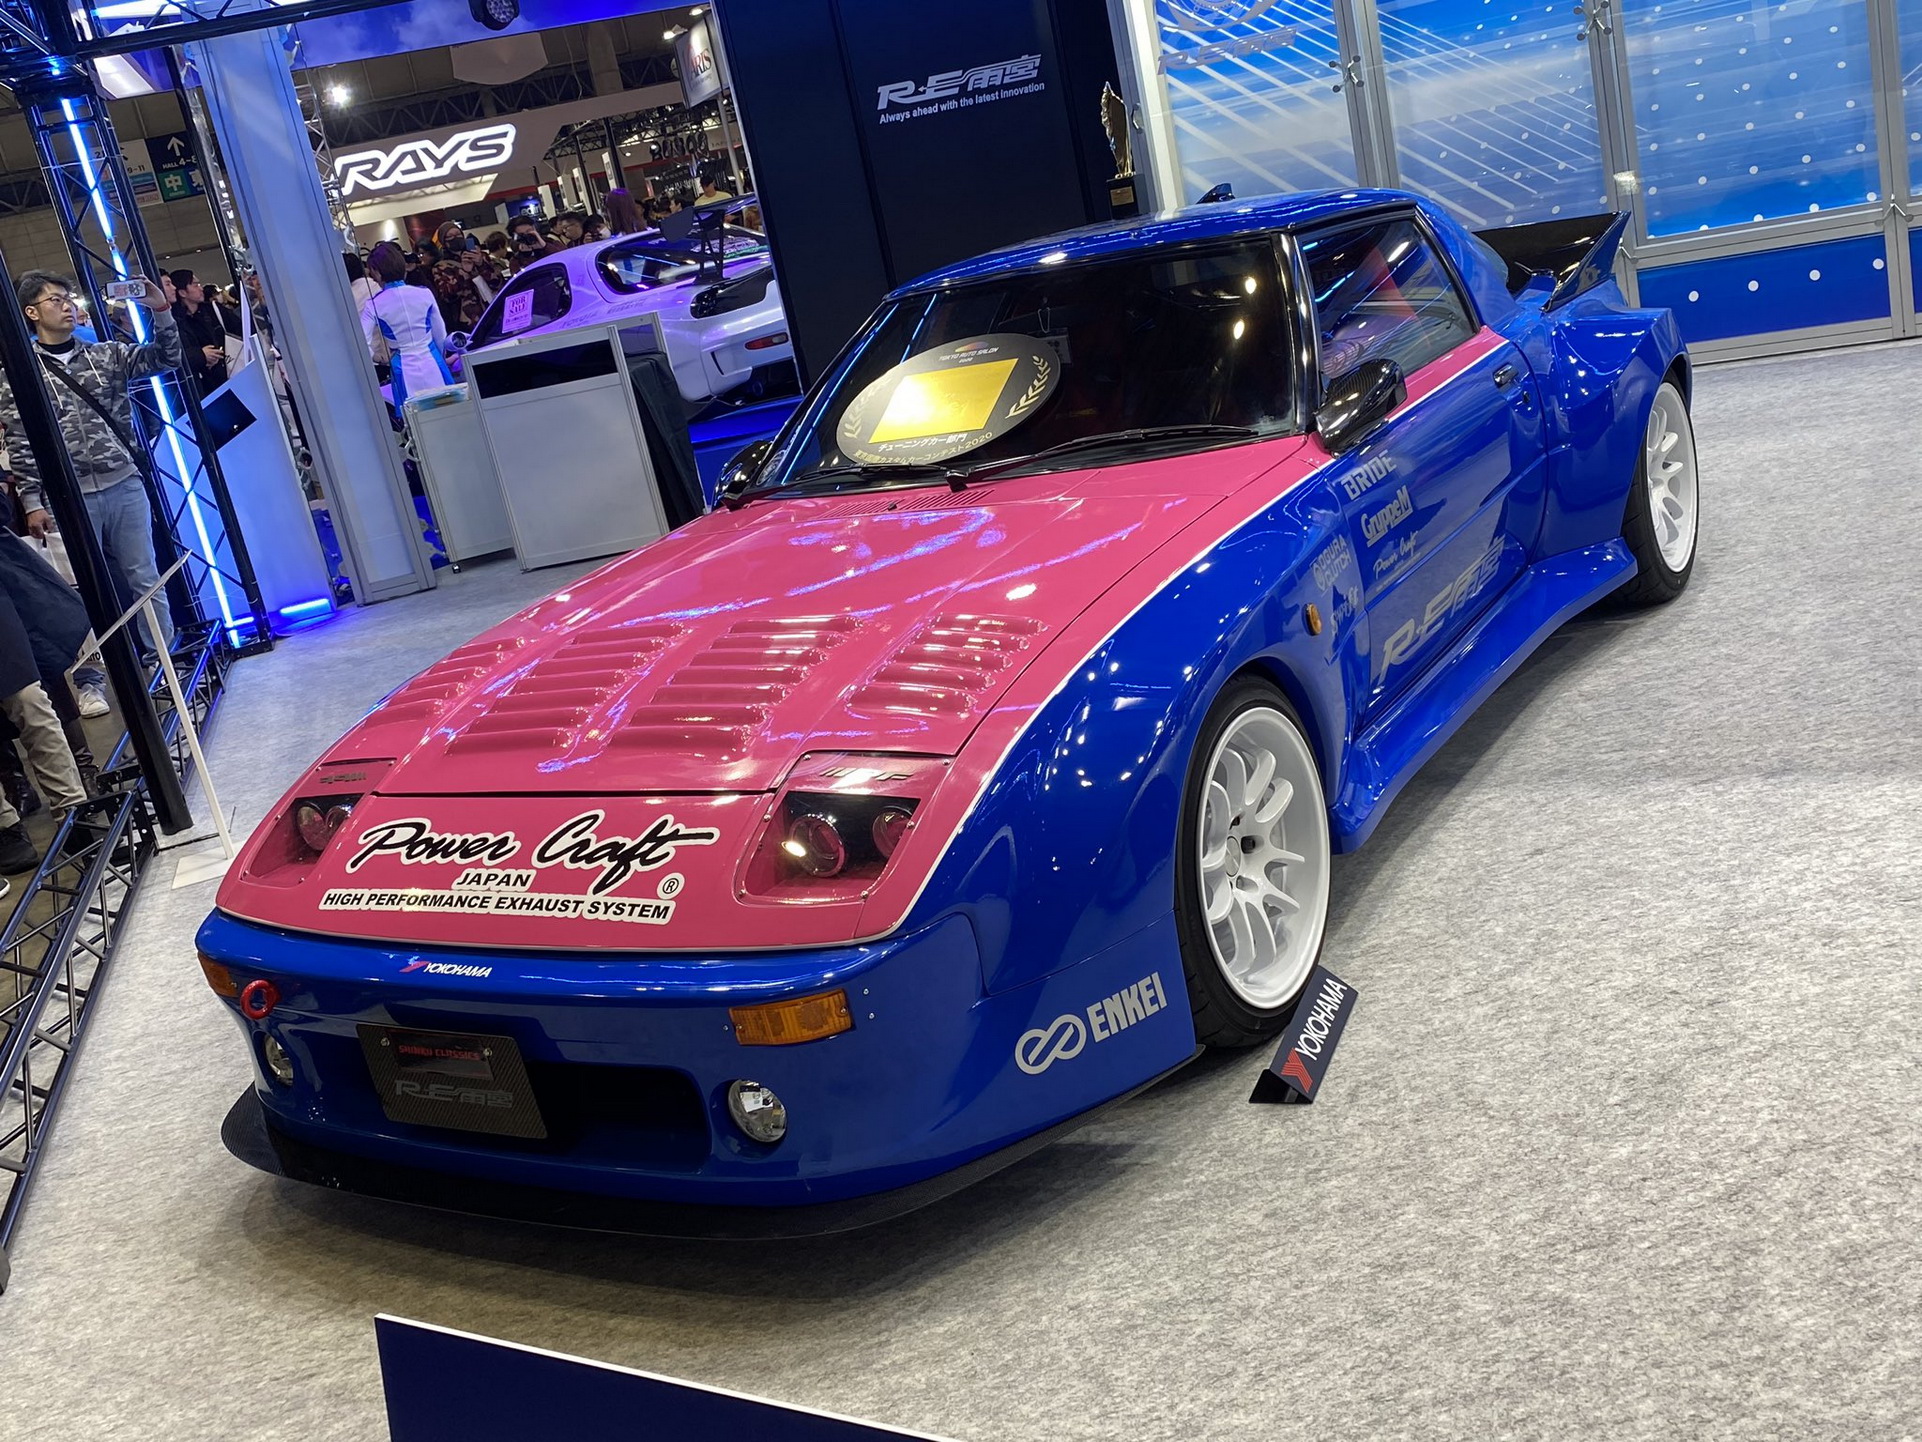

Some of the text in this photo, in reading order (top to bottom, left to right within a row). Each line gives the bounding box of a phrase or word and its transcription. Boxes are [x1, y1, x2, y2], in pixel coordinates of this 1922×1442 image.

[879, 82, 1045, 124] Always ahead with the latest innovation
[162, 162, 178, 170] HALL
[335, 124, 516, 195] RAYS
[164, 173, 183, 191] 中
[1340, 449, 1398, 500] BRIDE
[350, 813, 715, 896] Power Craft
[457, 871, 531, 888] JAPAN
[323, 892, 671, 920] HIGH PERFORMANCE EXHAUST SYSTEM
[423, 962, 493, 978] YOKOHAMA
[1086, 971, 1168, 1043] ENKEI
[1294, 977, 1347, 1061] YOKOHAMA
